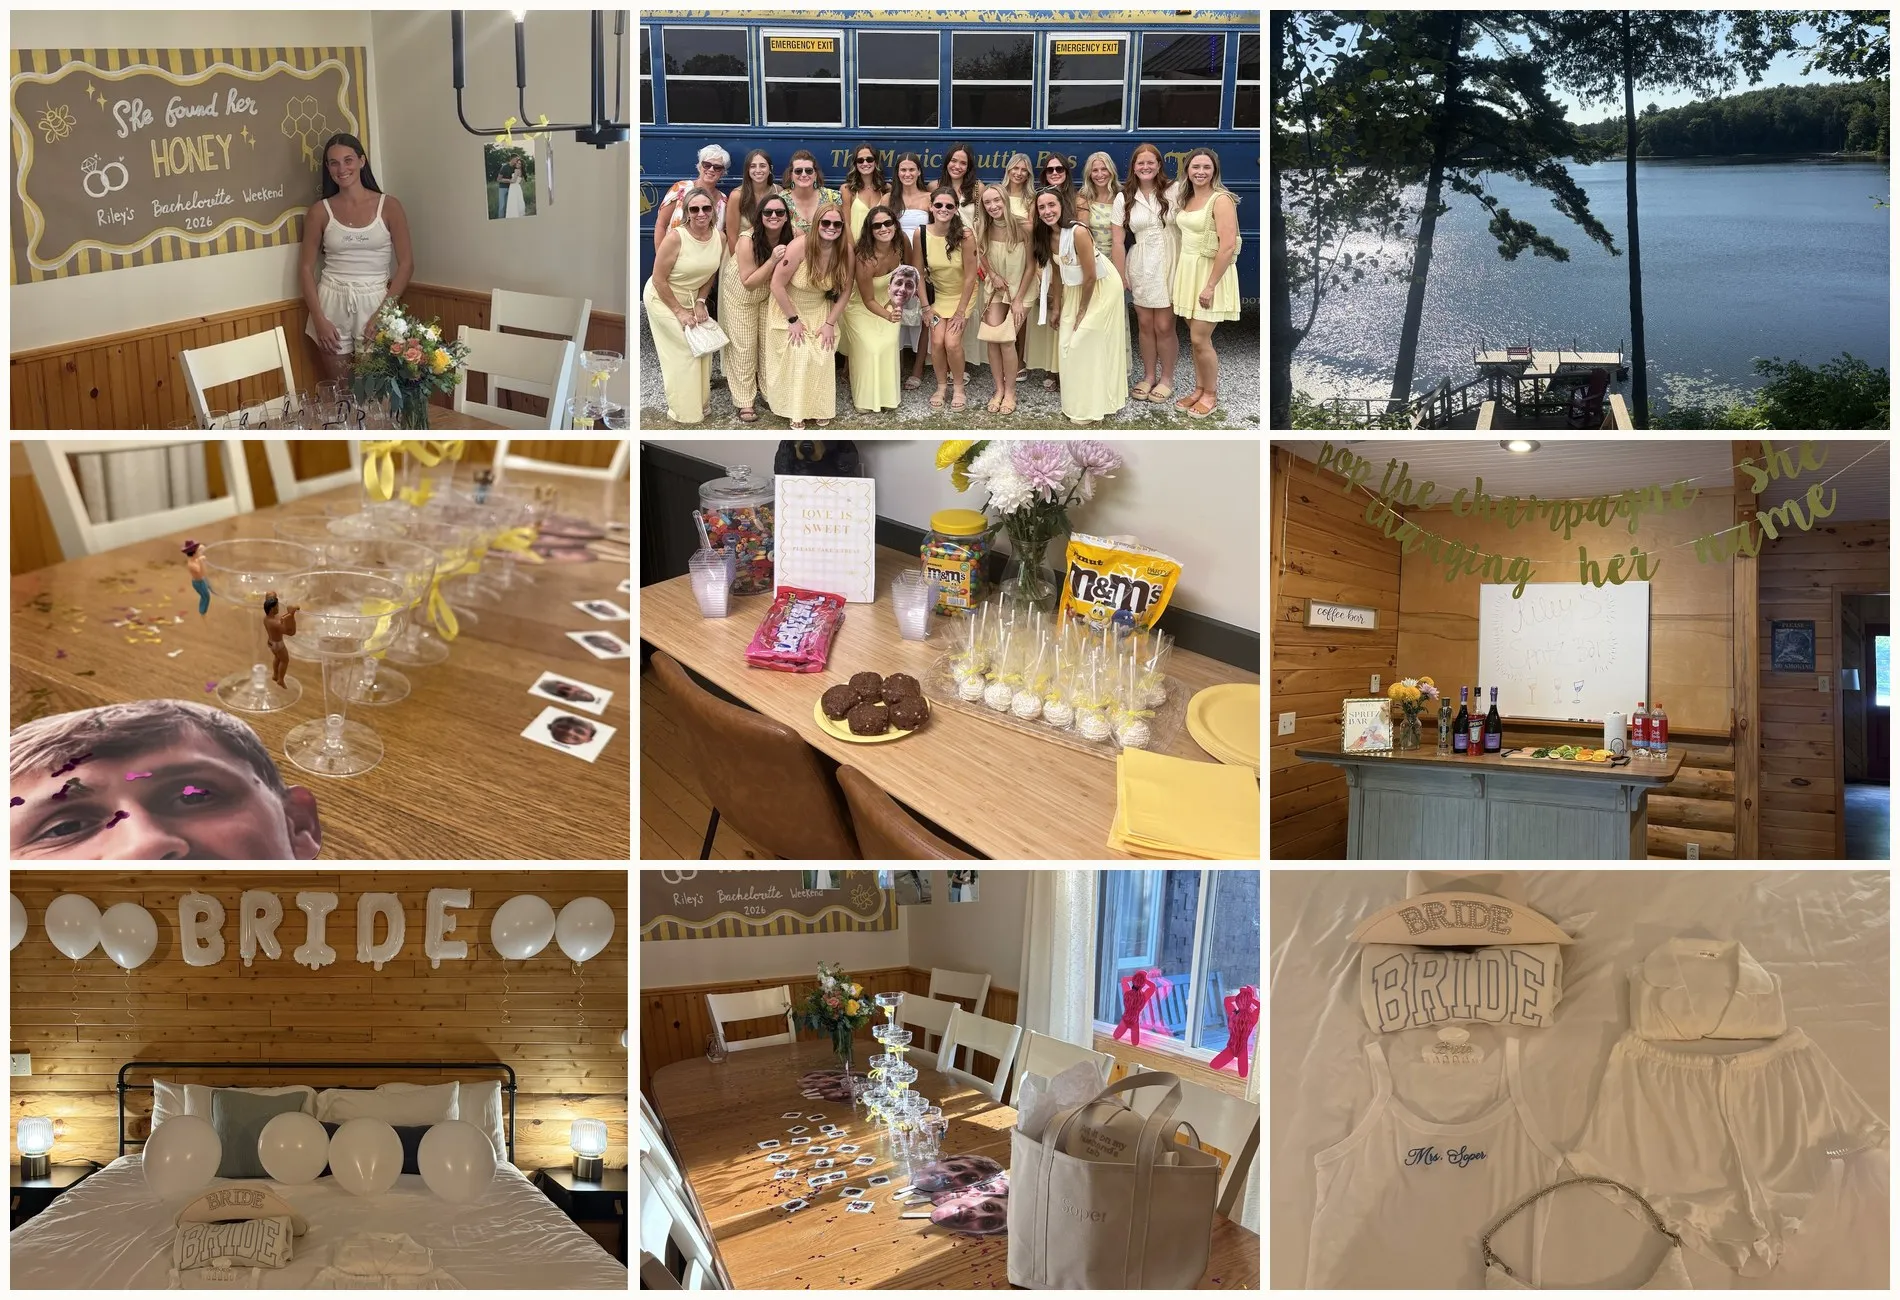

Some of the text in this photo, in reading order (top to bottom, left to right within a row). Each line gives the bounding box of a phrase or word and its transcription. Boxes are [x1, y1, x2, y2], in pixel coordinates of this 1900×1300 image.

[771, 40, 833, 50] EMERGENCY EXIT
[1056, 43, 1118, 52] EMERGENCY EXIT
[113, 88, 258, 138] She found her
[151, 134, 232, 178] HONEY
[831, 149, 854, 168] Th
[879, 148, 942, 168] Mic
[97, 184, 284, 226] Riley's Bachelorette Weekend
[185, 216, 213, 230] 2026
[1314, 440, 1829, 541] pop the champagne she
[802, 509, 852, 521] LOVE IS
[803, 524, 851, 535] SWEET
[1365, 484, 1837, 599] changing her name
[1317, 607, 1365, 624] coffee bar
[673, 885, 824, 907] Riley's Bachelorette Weekend
[744, 905, 767, 916] 2026
[1399, 900, 1514, 935] BRIDE
[179, 888, 472, 971] BRIDE
[1373, 949, 1545, 1033] BRIDE
[1404, 1145, 1487, 1168] Mrs. Soper
[206, 1188, 265, 1210] BRIDE
[1062, 1199, 1107, 1222] Soper
[180, 1219, 280, 1271] BRIDE
